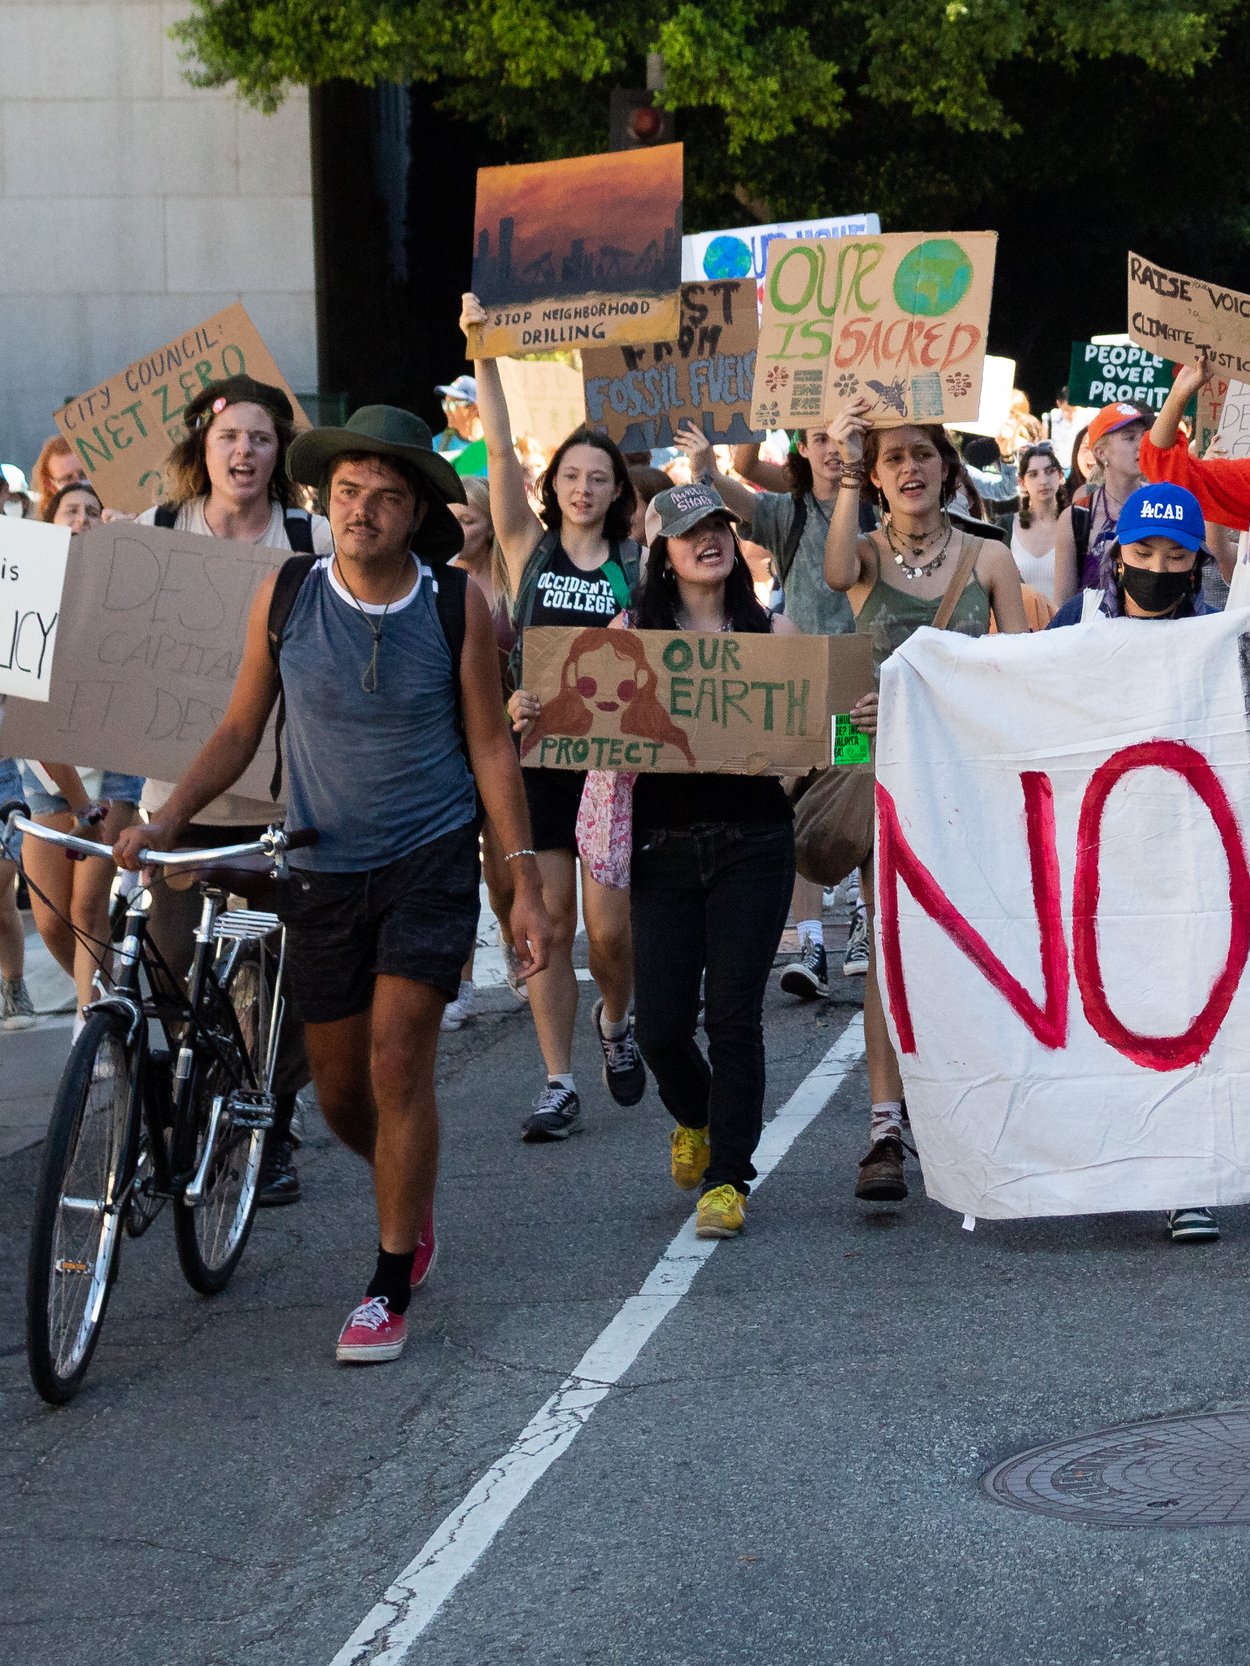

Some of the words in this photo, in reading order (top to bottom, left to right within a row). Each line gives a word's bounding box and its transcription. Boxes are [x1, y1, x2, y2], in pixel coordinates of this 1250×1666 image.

[770, 242, 886, 317] OUR
[1130, 257, 1192, 302] RAISE
[494, 311, 532, 327] STOP
[542, 300, 651, 321] NEIGHBORHOOD
[1132, 311, 1195, 345] CLIMATE
[522, 322, 606, 346] DRILLING
[766, 320, 832, 361] IS
[833, 317, 982, 372] SACRED
[1084, 344, 1164, 369] PEOPLE
[1102, 364, 1155, 384] OVER
[63, 385, 111, 430] CITY
[75, 400, 149, 473] NET
[151, 344, 247, 425] ZERO
[585, 361, 685, 422] FOSSIL
[1088, 381, 1169, 409] PROFIT
[102, 536, 281, 638] DEST
[542, 589, 616, 615] COLLEGE
[661, 638, 742, 674] OUR
[57, 678, 131, 734] IT
[669, 677, 811, 738] EARTH
[538, 734, 665, 768] PROTECT
